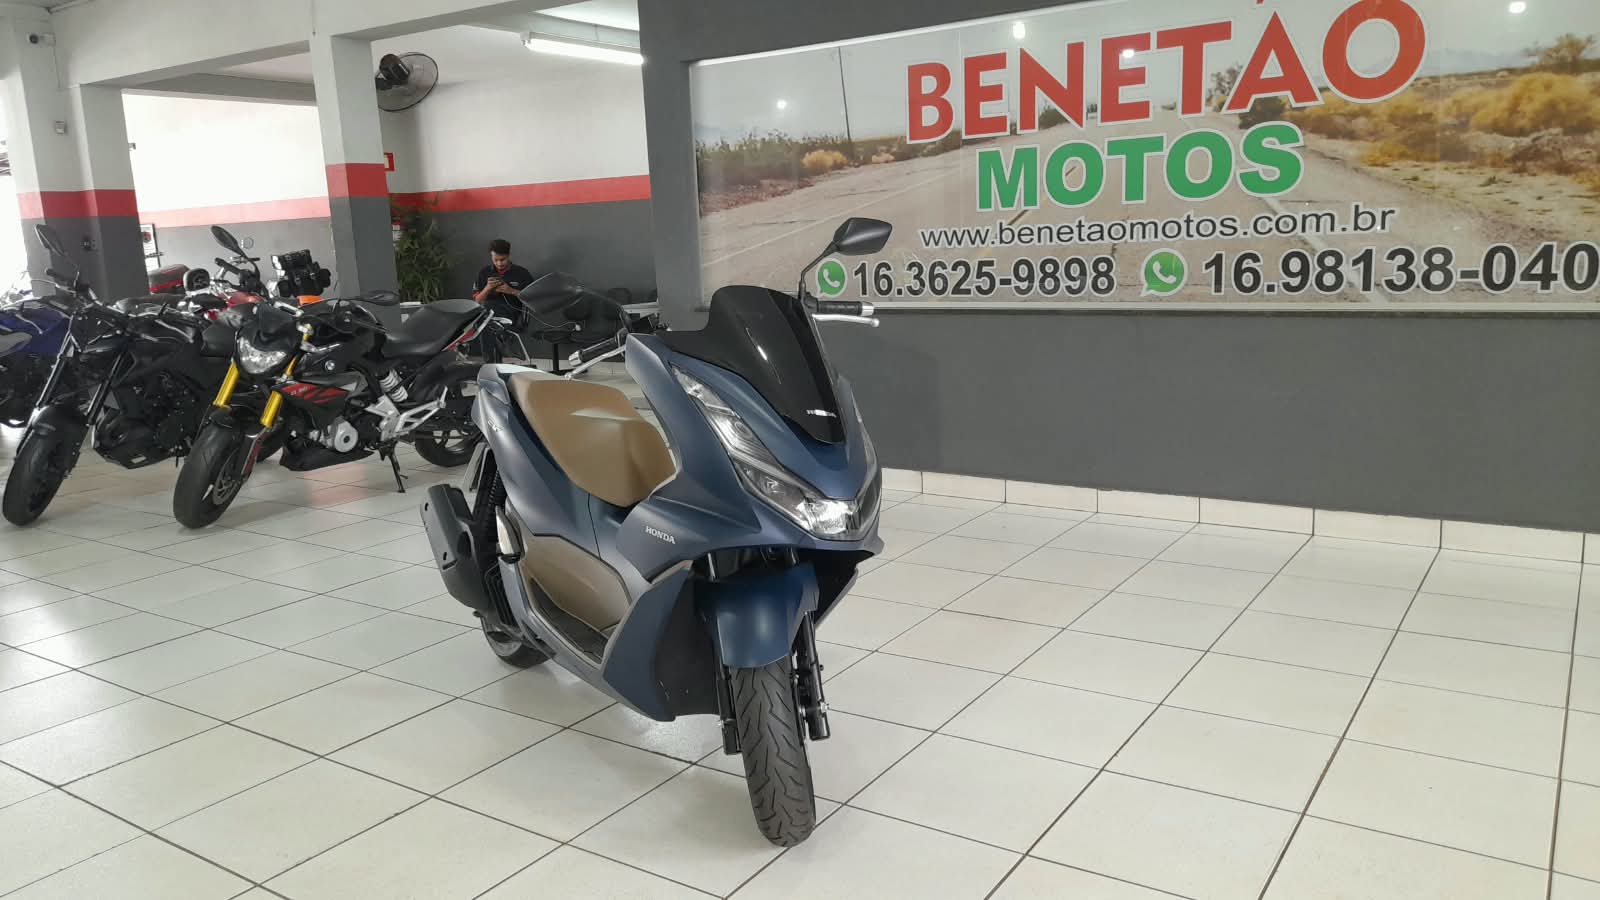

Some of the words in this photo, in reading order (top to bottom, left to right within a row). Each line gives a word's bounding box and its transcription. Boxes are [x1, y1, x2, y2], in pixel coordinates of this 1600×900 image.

[978, 122, 1303, 210] MOTOS
[921, 205, 1395, 248] www.benetaomotos.com.br
[854, 257, 1114, 297] 16.3625-9898
[1204, 242, 1600, 293] 16.98138-040
[645, 525, 676, 544] HONDA
